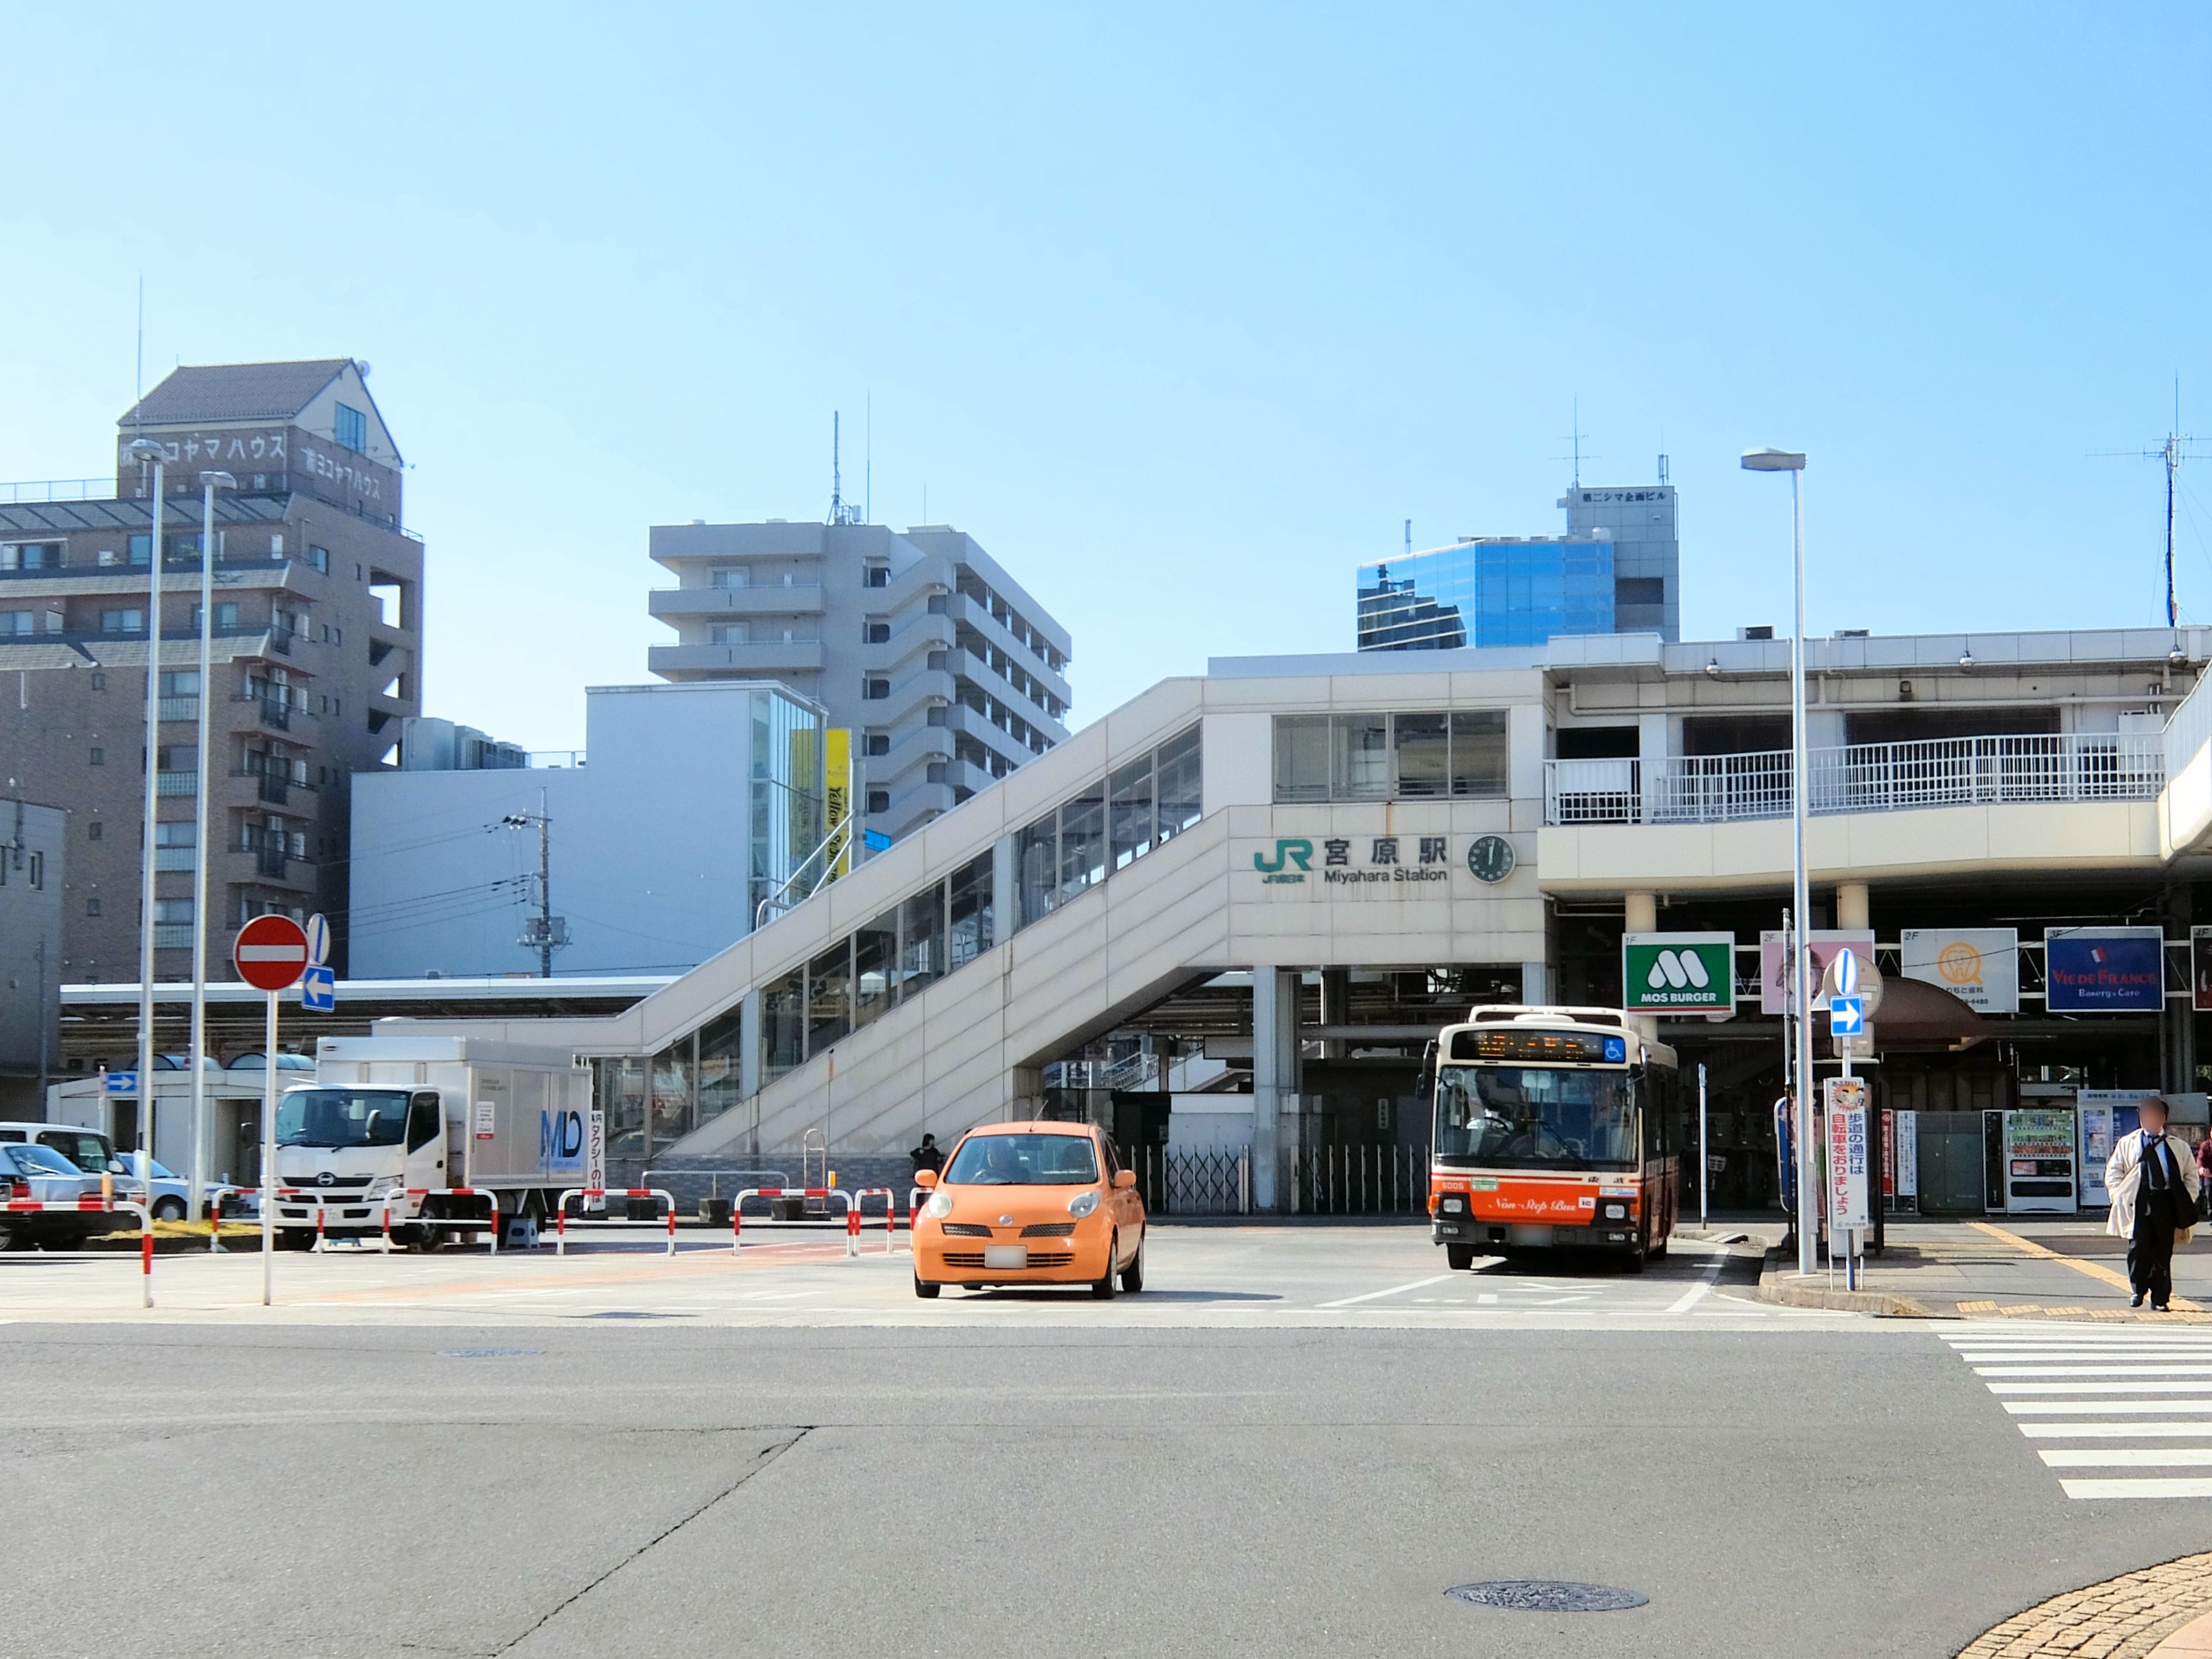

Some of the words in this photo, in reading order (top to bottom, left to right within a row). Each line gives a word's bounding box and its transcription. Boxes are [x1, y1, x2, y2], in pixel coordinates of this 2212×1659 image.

[119, 435, 285, 467] コヤマハウス
[829, 787, 842, 827] Yellow
[1254, 839, 1313, 872] JR
[1325, 837, 1446, 866] 宮原駅
[1325, 870, 1390, 884] Miyahara
[1394, 869, 1448, 882] Station
[1626, 936, 1636, 944] 1F
[1763, 934, 1776, 942] 2F
[1904, 932, 1919, 940] 2F
[2050, 930, 2062, 939] 3F
[2194, 929, 2208, 937] 4F
[2098, 968, 2156, 985] FRANCE
[1641, 993, 1669, 1003] MOS
[1670, 992, 1717, 1002] BURGER
[1848, 1112, 1865, 1175] 歩道の通行は
[1831, 1113, 1848, 1215] 自転車をおりましょう
[1549, 1200, 1576, 1211] Bus
